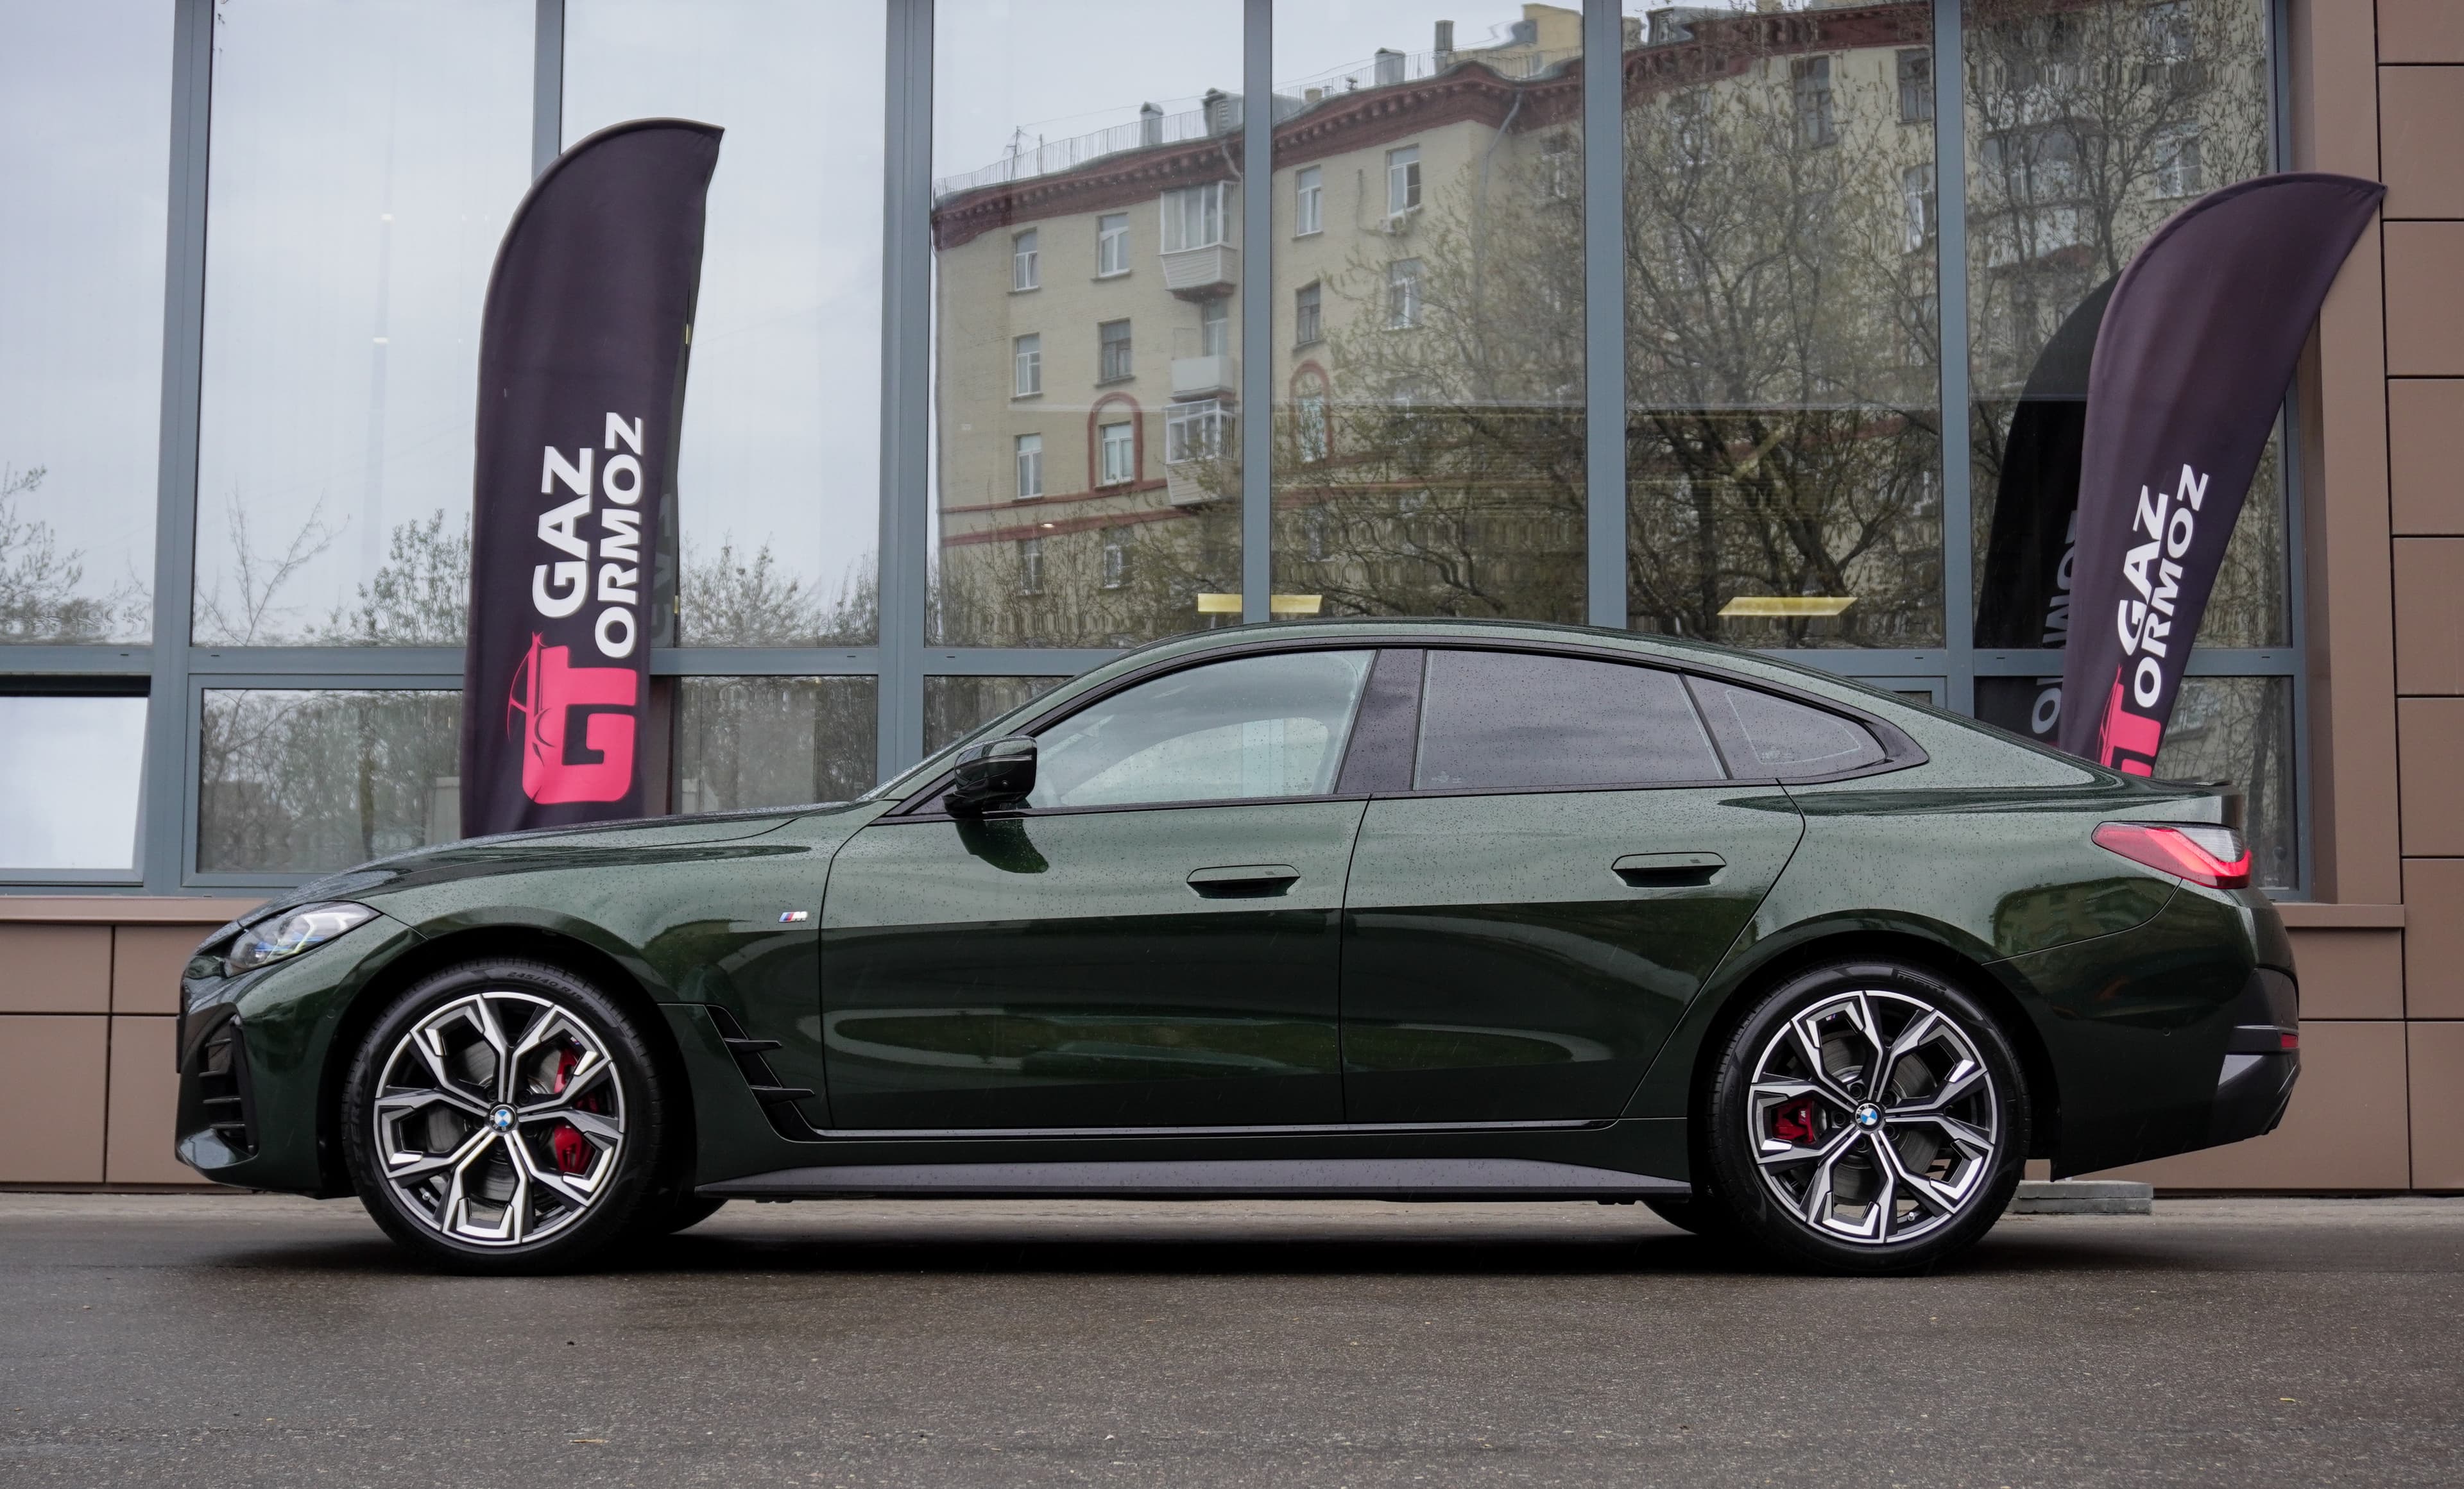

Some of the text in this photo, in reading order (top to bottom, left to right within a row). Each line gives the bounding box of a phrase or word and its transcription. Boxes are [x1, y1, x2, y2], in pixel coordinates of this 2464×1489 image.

[532, 445, 594, 618] GAZ
[595, 412, 642, 658] ORMOZ
[2118, 485, 2168, 656] GAZ
[2134, 463, 2209, 708] ORMOZ
